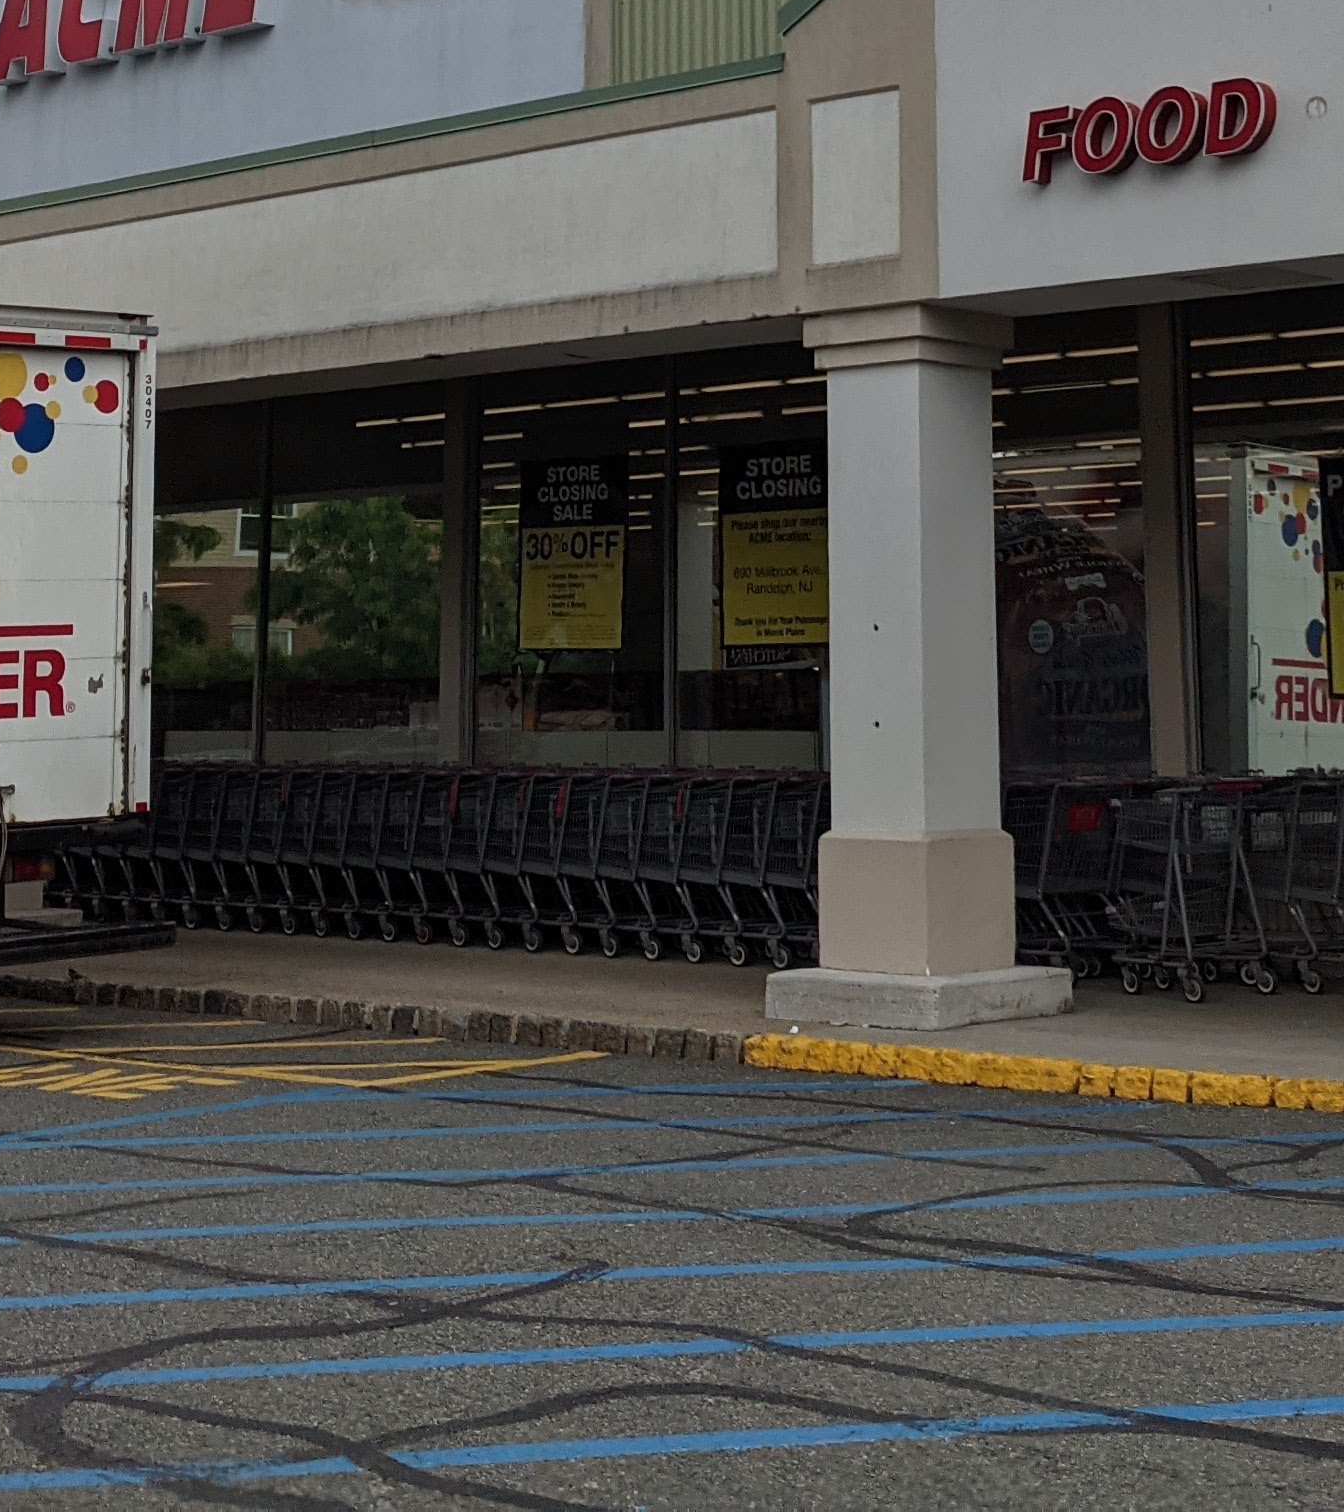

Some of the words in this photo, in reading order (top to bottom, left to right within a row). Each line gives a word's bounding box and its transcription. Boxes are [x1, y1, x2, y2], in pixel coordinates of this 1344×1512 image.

[1021, 74, 1278, 185] FOOD
[546, 464, 601, 483] STORE
[746, 455, 812, 478] STORE
[537, 482, 609, 503] CLOSING
[736, 476, 822, 501] CLOSING
[553, 503, 594, 522] SALE
[526, 532, 568, 561] 30%
[570, 530, 620, 559] OFF
[798, 579, 813, 593] NJ
